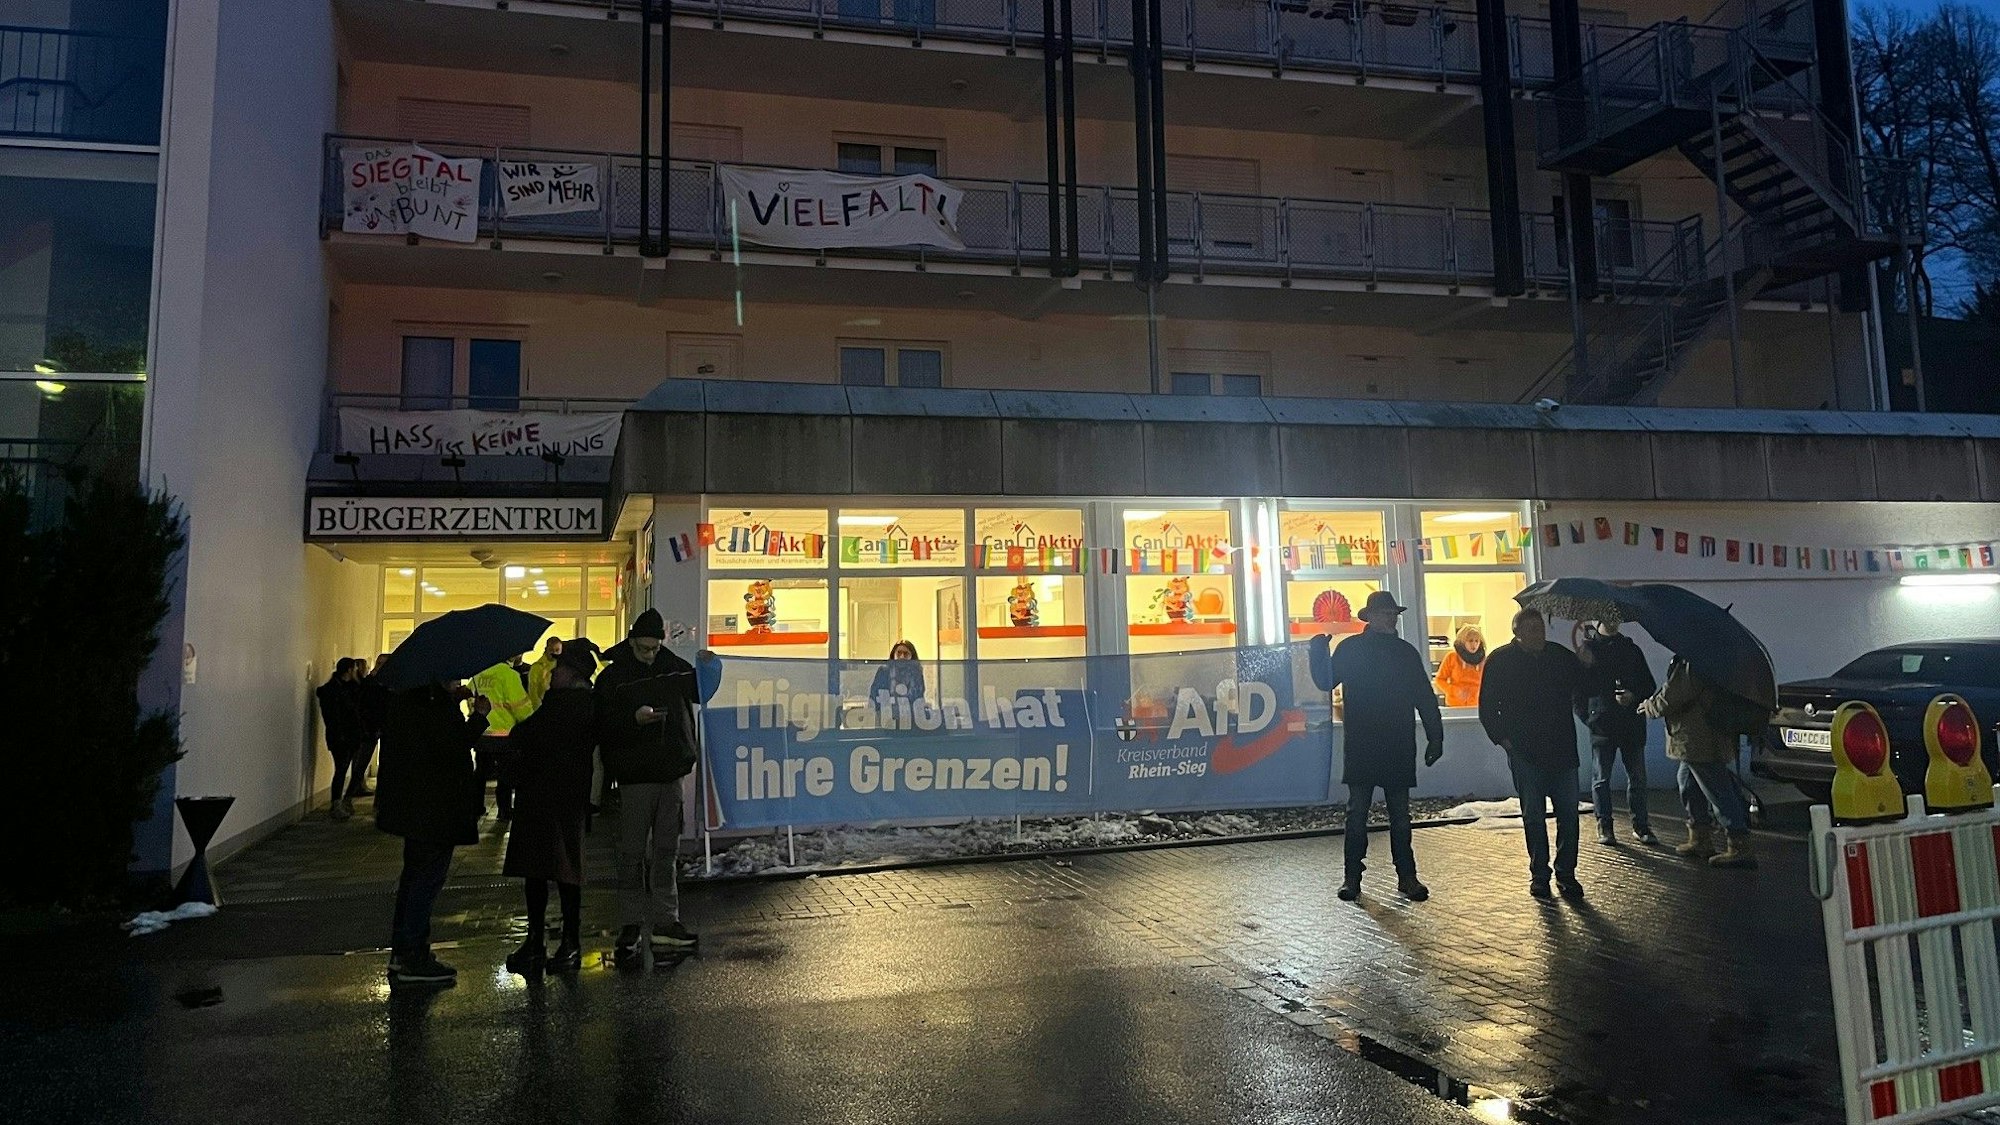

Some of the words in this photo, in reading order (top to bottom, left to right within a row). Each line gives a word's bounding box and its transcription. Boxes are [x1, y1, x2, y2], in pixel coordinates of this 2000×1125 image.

[365, 148, 392, 161] DAS
[351, 154, 472, 188] SIEGTAL
[503, 163, 540, 179] WIR
[507, 182, 545, 202] SIND
[548, 180, 596, 206] MEHR
[397, 197, 468, 231] BUNT
[370, 424, 433, 455] HASS
[472, 422, 541, 452] KEINE
[316, 499, 598, 532] BÜRGERZENTRUM
[1038, 534, 1083, 551] Aktiv
[1133, 534, 1163, 549] Can
[736, 679, 974, 743] Migration
[979, 684, 1066, 730] hat
[1166, 678, 1277, 740] AfD
[1117, 742, 1208, 763] Kreisverband
[736, 745, 834, 801] ihre
[849, 744, 1069, 795] Grenzen!
[1128, 760, 1207, 780] Rhein-Sieg
